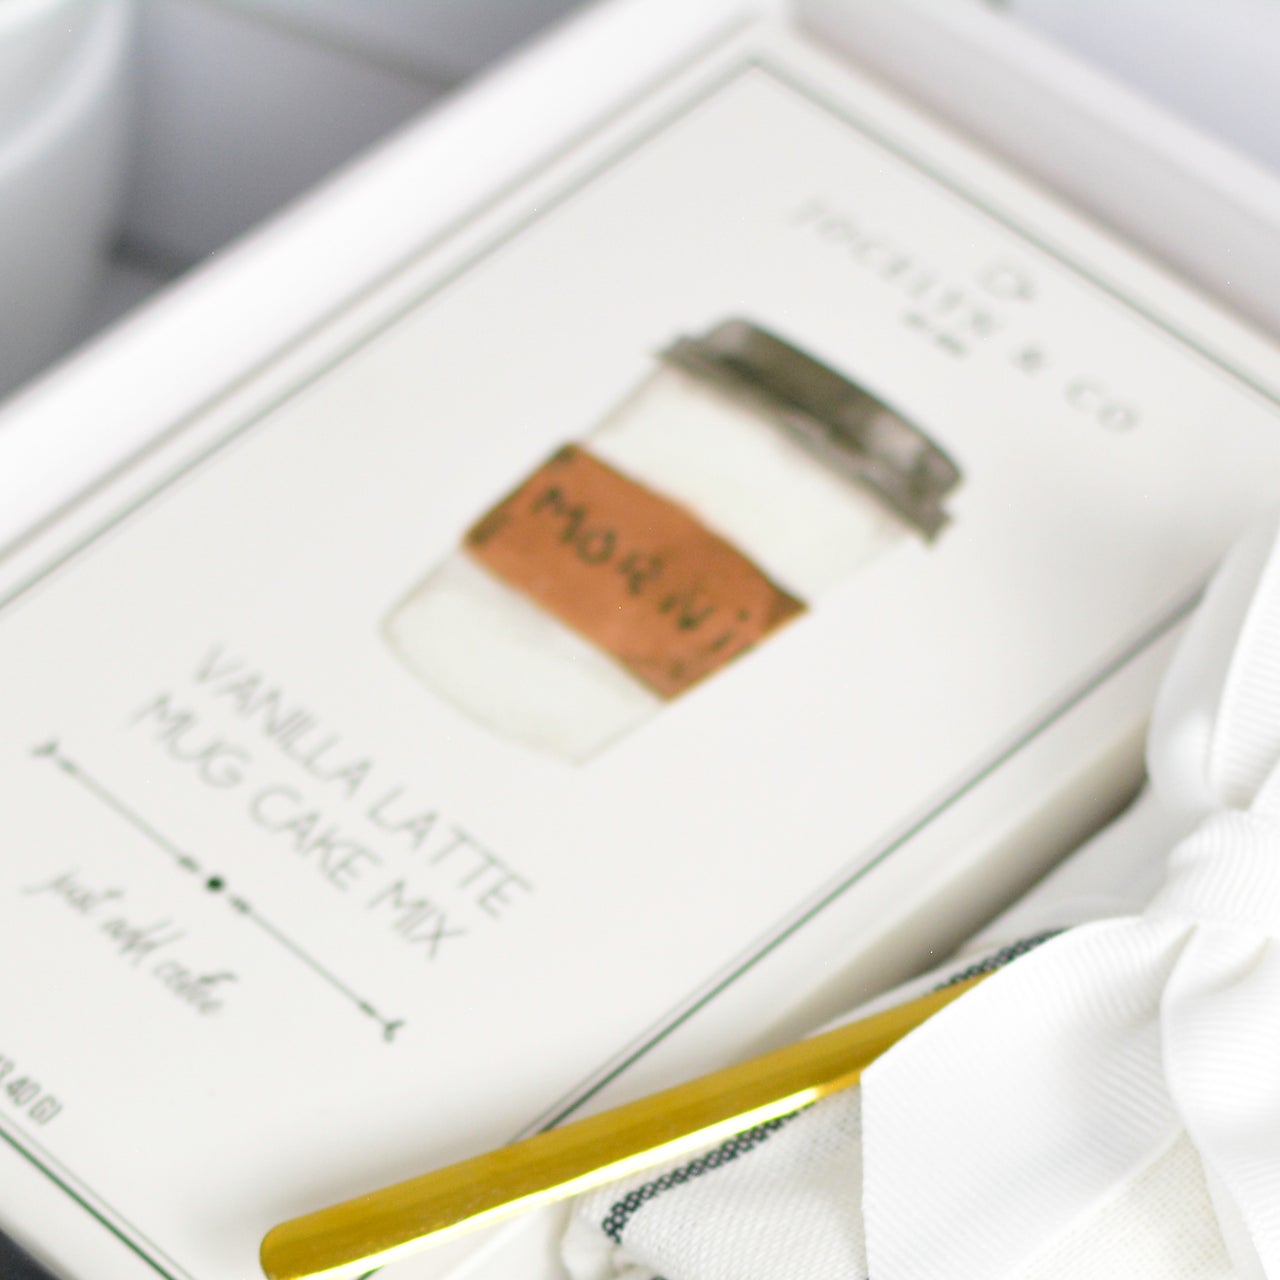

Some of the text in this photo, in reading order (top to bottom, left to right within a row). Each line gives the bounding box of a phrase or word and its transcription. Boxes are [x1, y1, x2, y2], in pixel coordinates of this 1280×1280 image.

[127, 691, 469, 961] MUG CAKE MIX
[194, 643, 535, 919] VANILLA LATTE
